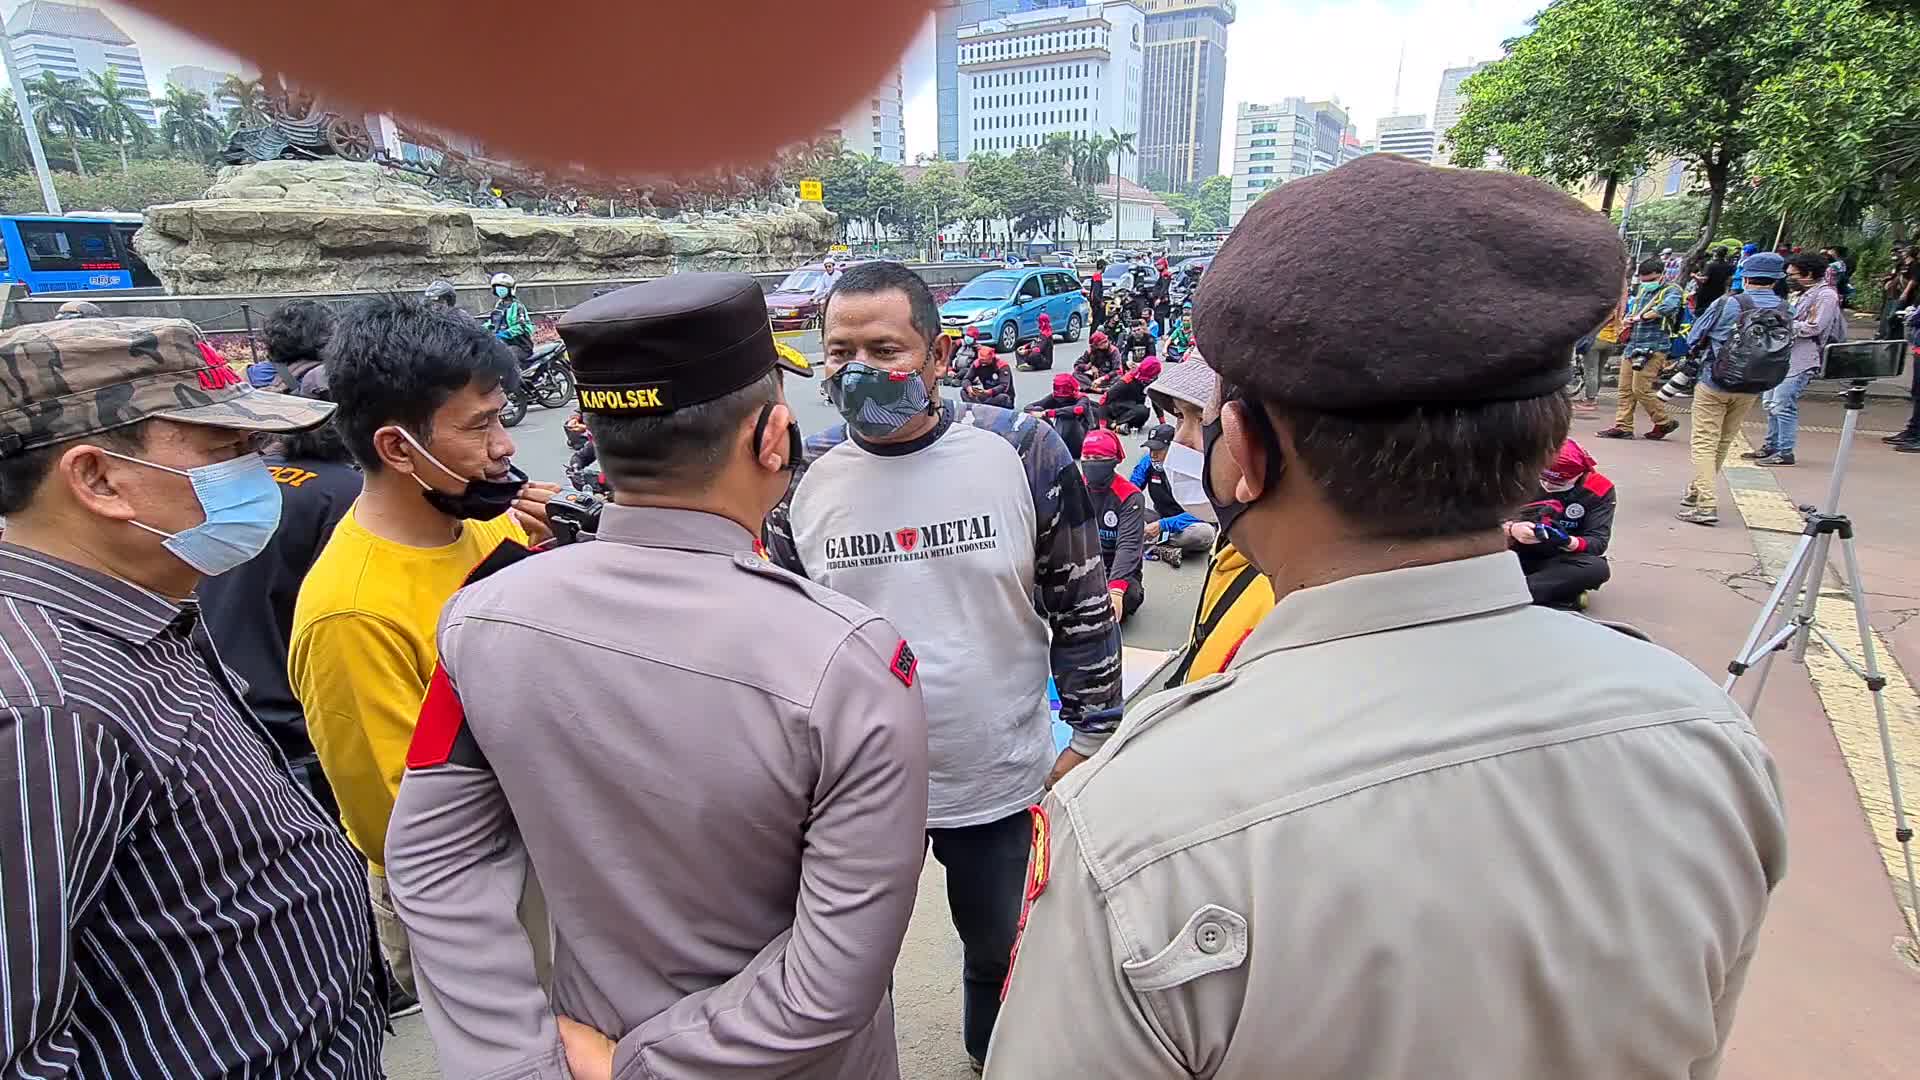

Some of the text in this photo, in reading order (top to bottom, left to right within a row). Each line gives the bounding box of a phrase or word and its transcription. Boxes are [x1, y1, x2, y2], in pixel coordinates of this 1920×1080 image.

[580, 388, 664, 409] KAPOLSEK
[825, 515, 997, 560] GARDA 17 METAL
[826, 540, 996, 570] FEDERASI SERIKAT PEKERJA METAL INDONESIA
